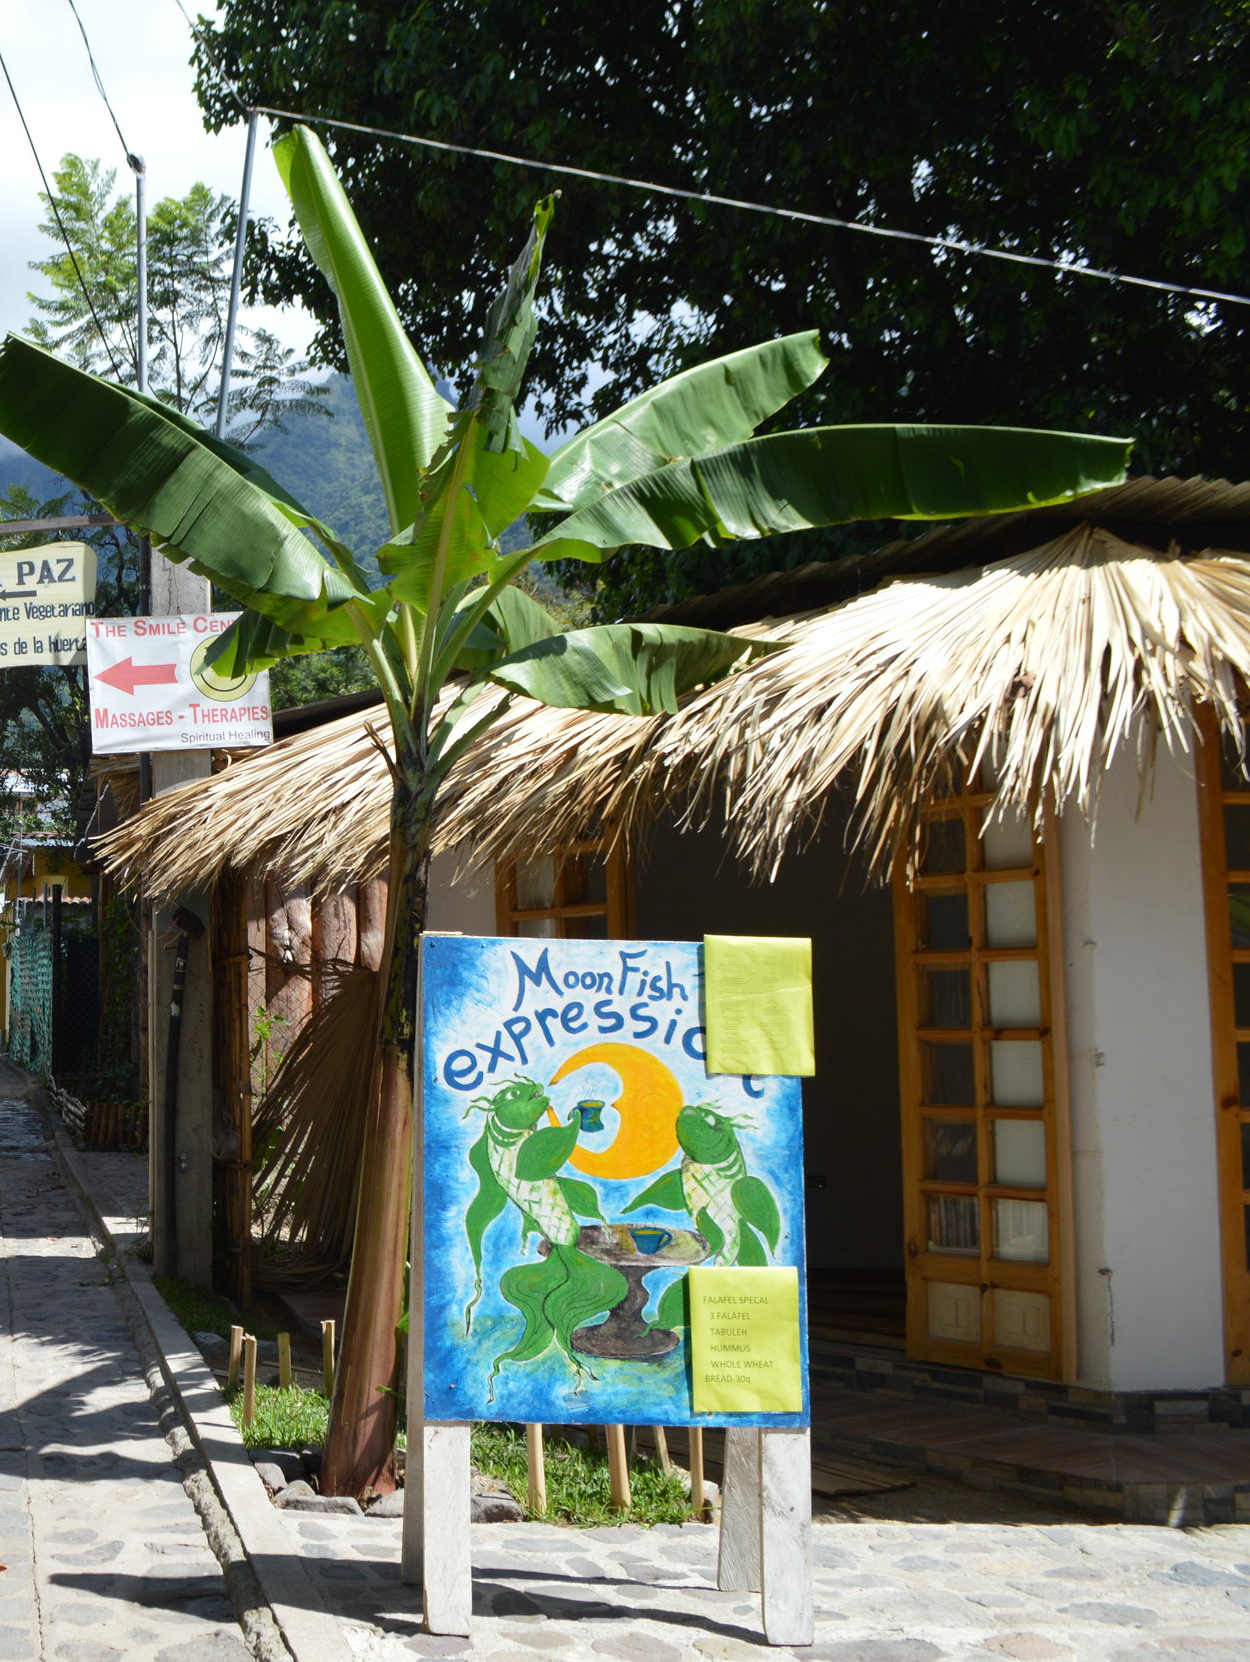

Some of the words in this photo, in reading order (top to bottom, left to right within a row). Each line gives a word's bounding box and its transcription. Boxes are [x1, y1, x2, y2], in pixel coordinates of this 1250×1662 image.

[16, 558, 76, 586] PAZ
[24, 601, 95, 621] Vegetariano
[91, 622, 127, 638] THE
[134, 619, 186, 636] SMILE
[14, 637, 28, 655] de
[33, 636, 43, 654] la
[49, 635, 87, 654] huerta
[95, 707, 173, 729] MASSAGES
[189, 703, 270, 725] THERAPIES
[181, 732, 225, 745] Spiritual
[229, 730, 270, 741] Healing
[444, 999, 764, 1098] expressio
[703, 1296, 737, 1305] FALAFEL
[739, 1296, 769, 1305] SPECAL
[710, 1312, 715, 1320] 3
[717, 1312, 751, 1320] FALAFEL
[710, 1328, 747, 1336] TABULEH
[710, 1344, 750, 1353] HUMMUS
[711, 1360, 741, 1369] WHOLE
[744, 1360, 773, 1369] WHEAT
